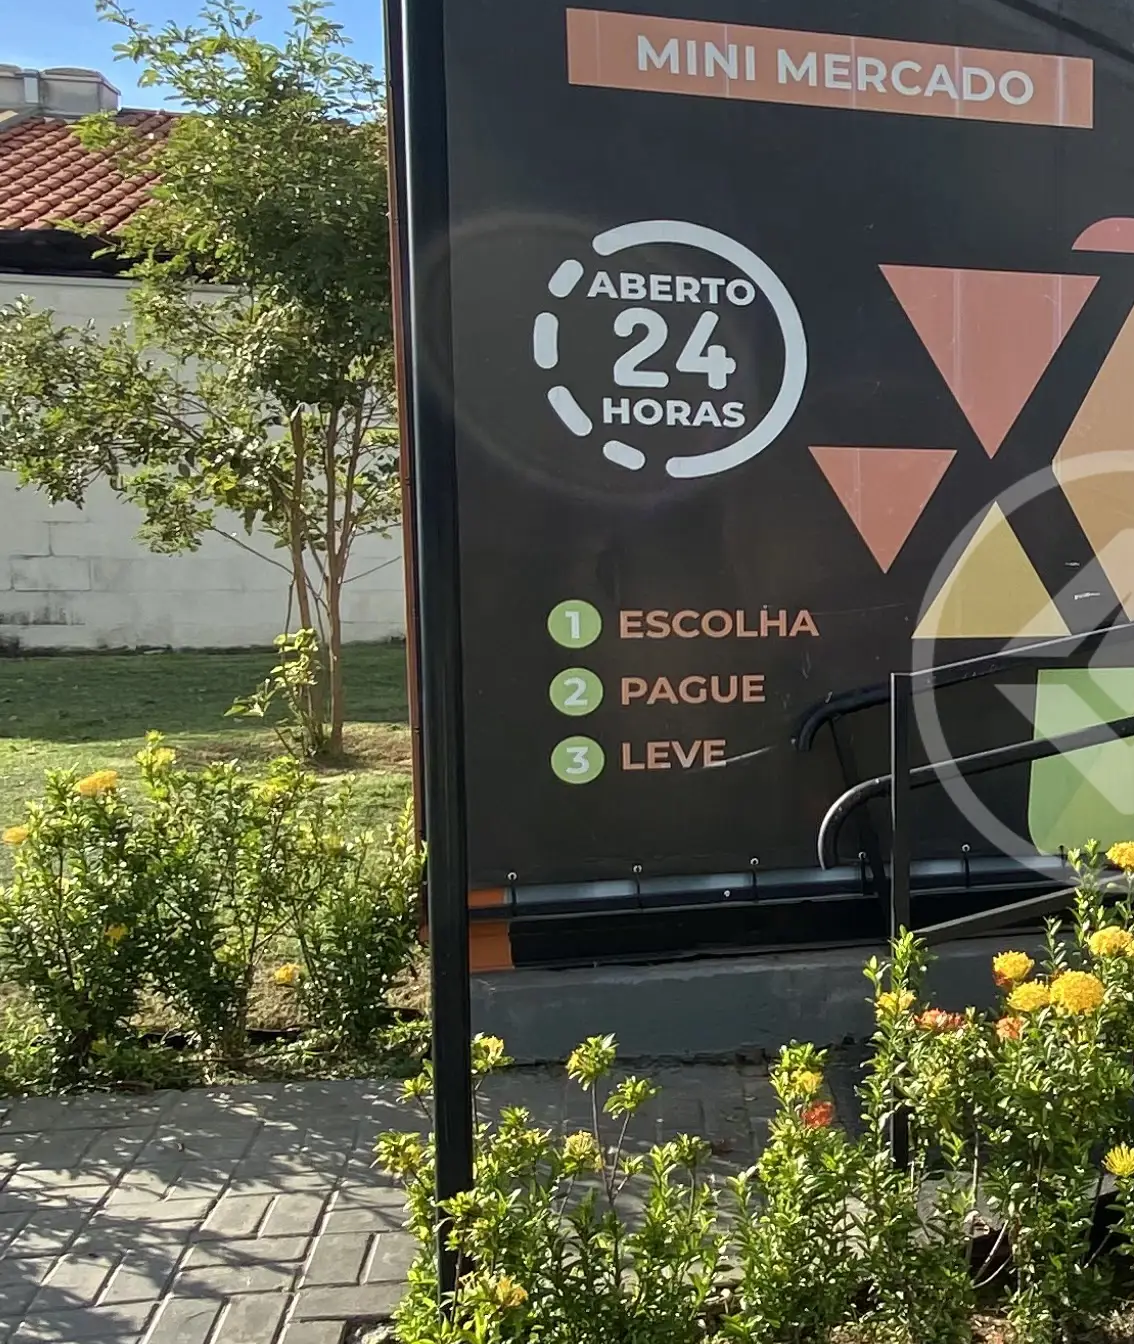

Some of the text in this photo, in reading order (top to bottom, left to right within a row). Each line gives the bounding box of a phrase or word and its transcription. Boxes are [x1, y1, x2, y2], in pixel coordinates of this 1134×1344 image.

[637, 35, 1034, 105] MINI MERCADO
[586, 270, 756, 307] ABERTO
[612, 308, 737, 390] 24
[602, 397, 746, 429] HORAS
[564, 608, 819, 639] 1 ESCOLHA
[563, 674, 765, 706] 2 PAGUE
[565, 739, 727, 775] 3 LEVE
